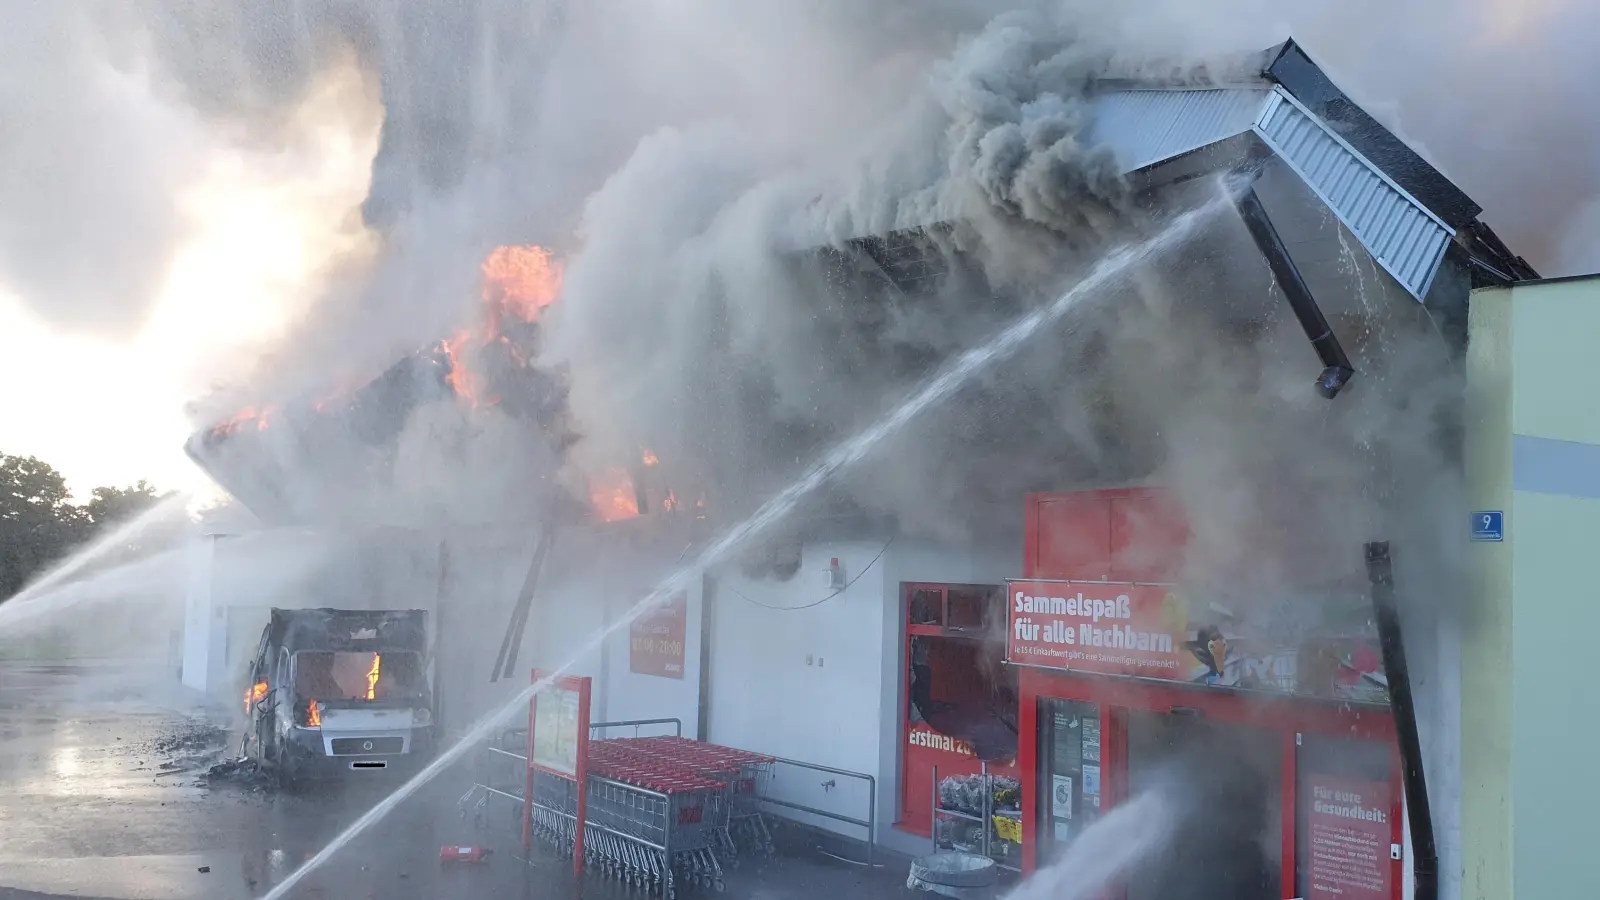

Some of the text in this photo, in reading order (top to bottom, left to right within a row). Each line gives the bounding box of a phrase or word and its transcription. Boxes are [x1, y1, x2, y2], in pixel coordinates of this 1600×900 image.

[1483, 514, 1492, 530] 9
[1015, 591, 1131, 622] Sammelspaß
[1015, 617, 1172, 653] für alle Nachbarn
[1033, 647, 1068, 659] Einkaufswert
[1086, 652, 1098, 662] eine
[1098, 653, 1136, 666] Sammelfigur
[909, 729, 954, 752] Erstmal
[1313, 786, 1361, 803] Für eure
[1314, 800, 1386, 823] Gesundheit:
